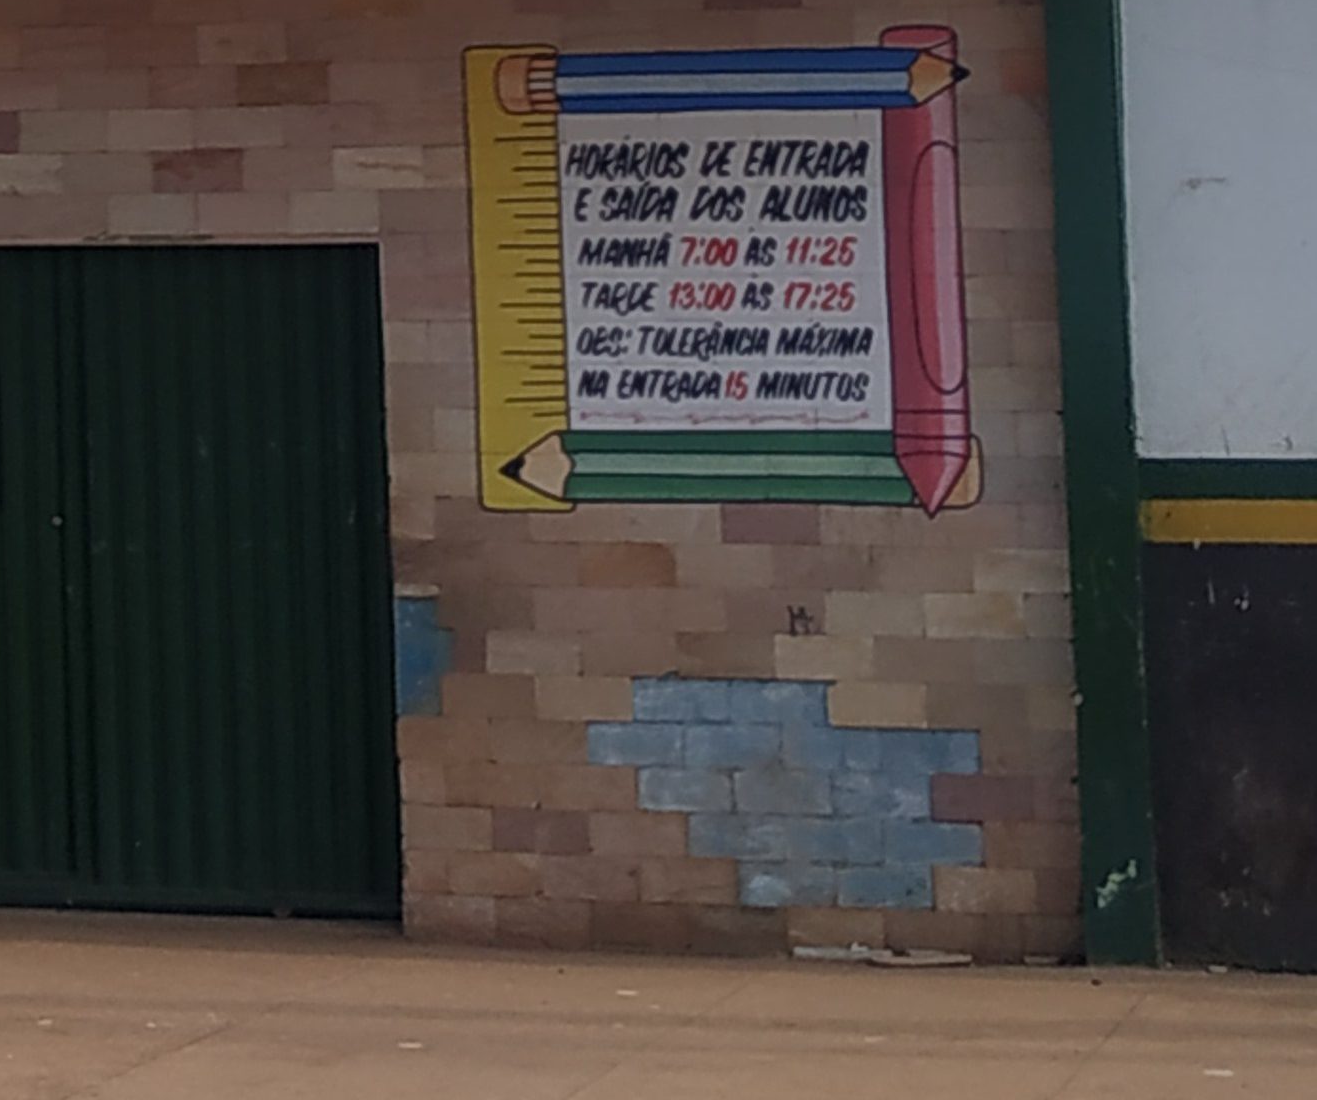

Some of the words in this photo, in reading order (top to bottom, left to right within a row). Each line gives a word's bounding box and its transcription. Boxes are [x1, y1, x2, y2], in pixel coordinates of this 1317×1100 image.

[699, 141, 736, 177] DE
[743, 140, 870, 179] ENTRADA
[574, 187, 592, 222] E
[599, 181, 679, 222] SAÍDA
[689, 185, 746, 223] DOS
[758, 185, 869, 223] ALUNOS
[680, 236, 739, 267] 7:00
[787, 236, 858, 267] 11:25
[581, 281, 659, 317] TARDE
[669, 281, 737, 311] 13:00
[783, 281, 856, 312] 17:25
[775, 320, 874, 358] MÁXIMA
[577, 369, 610, 399] NA
[617, 368, 722, 404] ENTRADA
[725, 371, 749, 402] 15
[755, 370, 870, 402] MINUTOS
